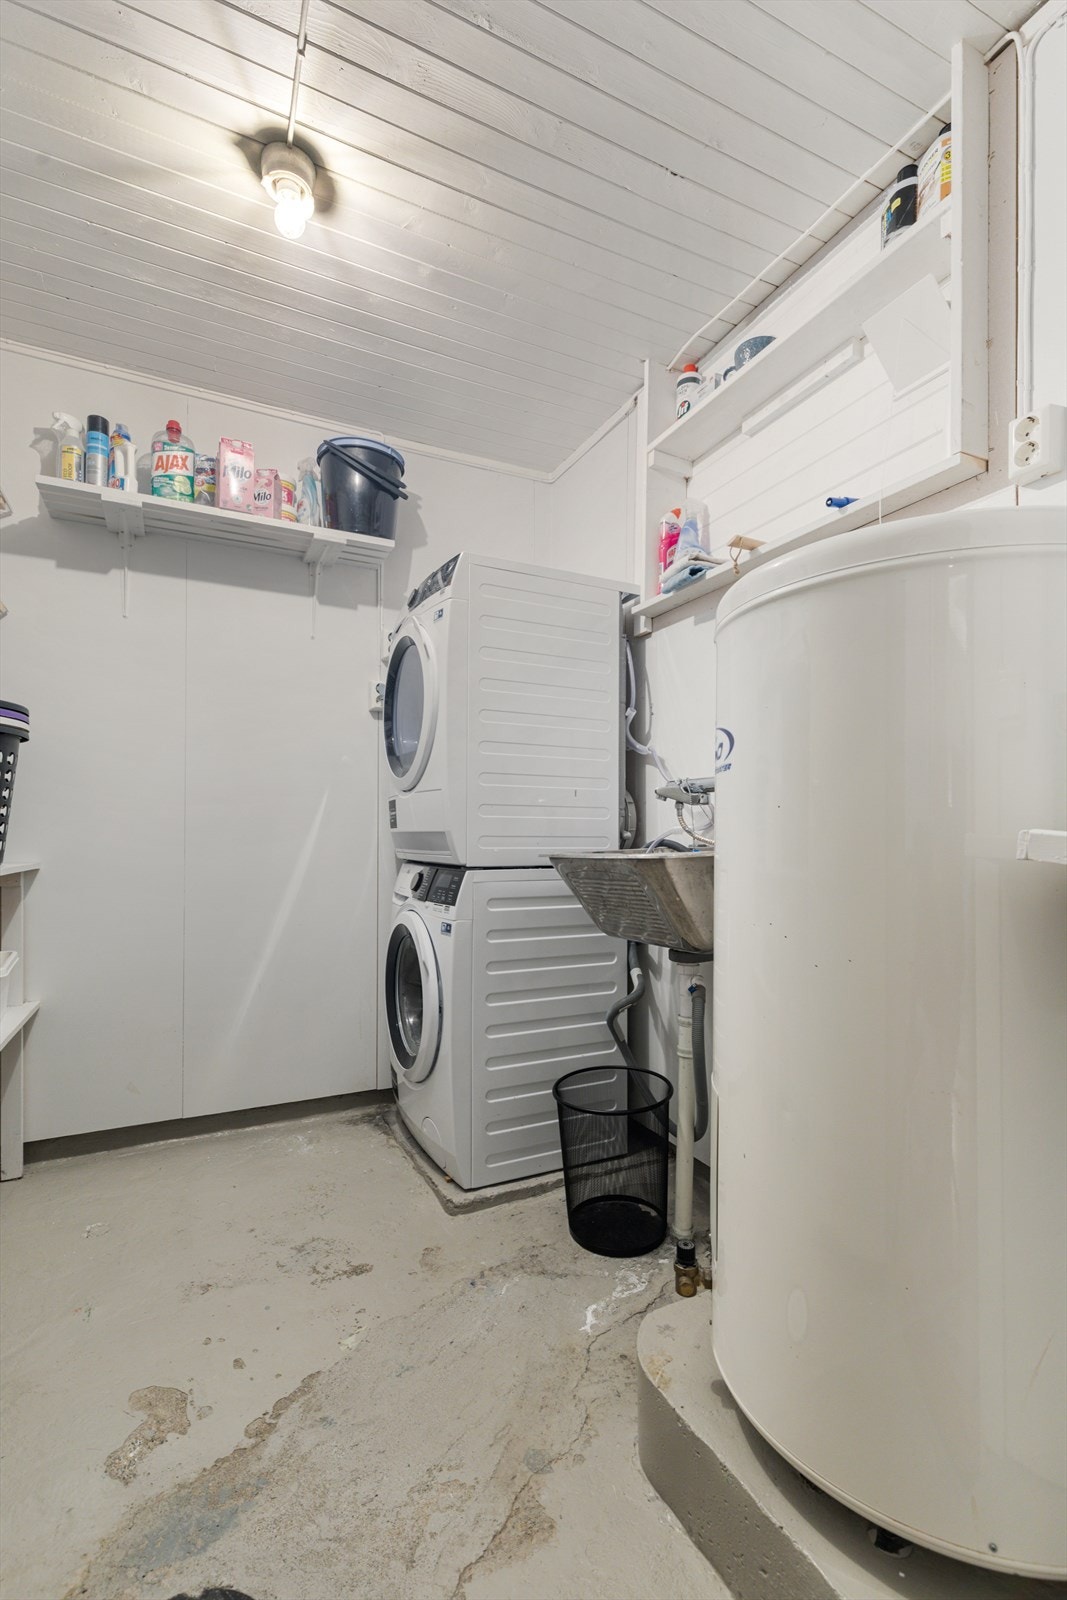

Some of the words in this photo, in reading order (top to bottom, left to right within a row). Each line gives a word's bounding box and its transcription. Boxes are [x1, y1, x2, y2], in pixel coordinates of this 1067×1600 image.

[154, 454, 189, 473] AJAX
[223, 464, 252, 479] Milo
[254, 493, 272, 502] Milo
